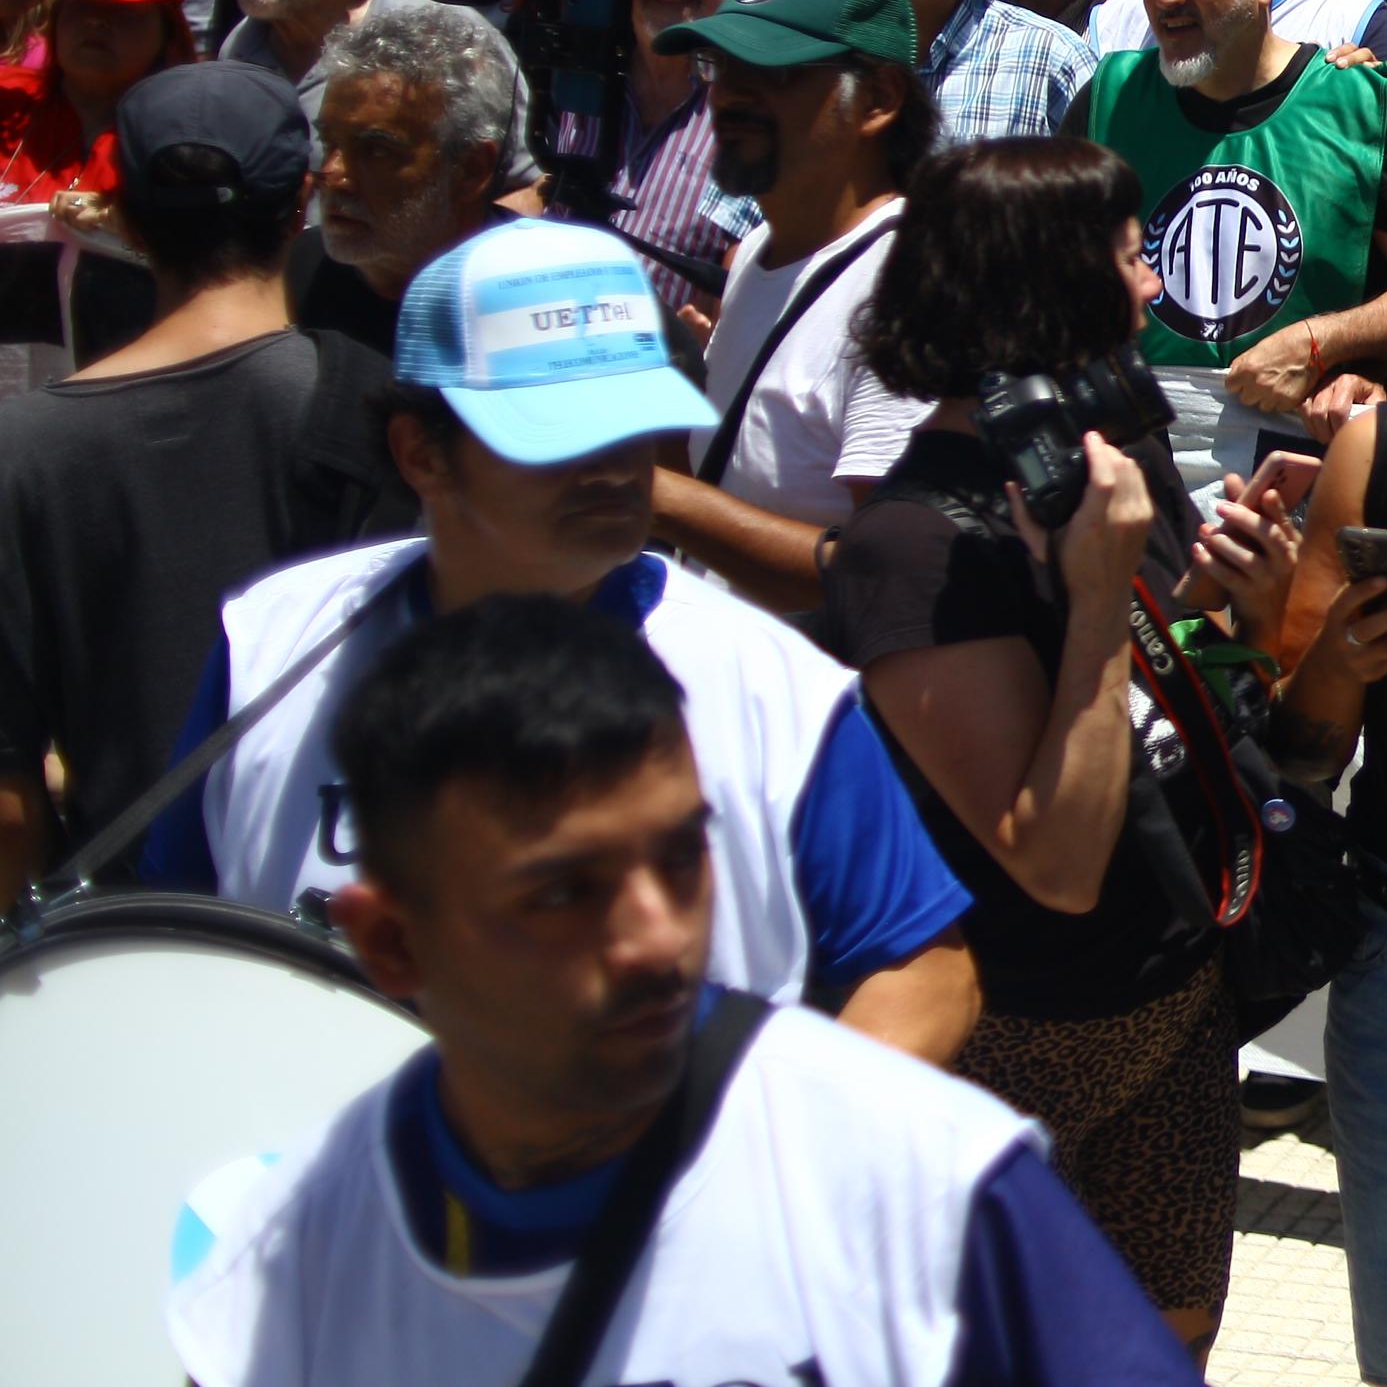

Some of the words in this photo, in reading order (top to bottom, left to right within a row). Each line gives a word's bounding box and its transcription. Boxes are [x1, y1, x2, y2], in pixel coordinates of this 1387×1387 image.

[1190, 173, 1213, 192] 100
[1215, 168, 1261, 192] AÑOS
[1169, 198, 1263, 304] ATE
[529, 301, 634, 331] UETTel
